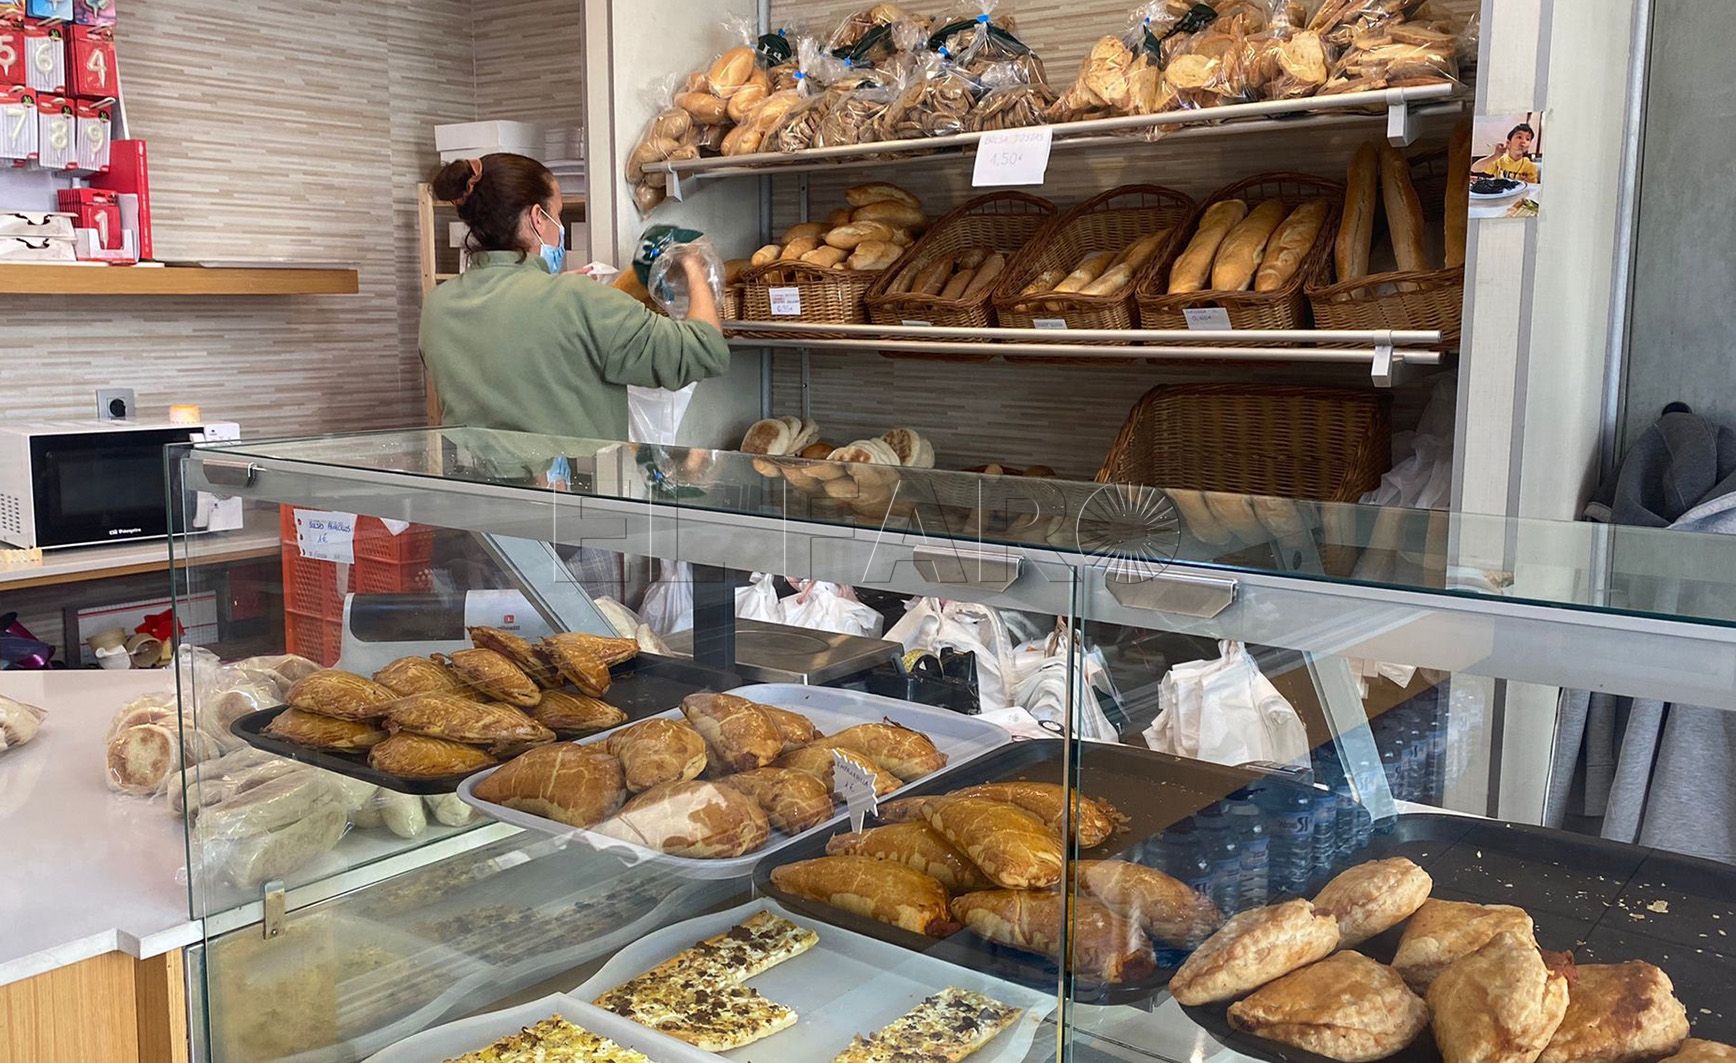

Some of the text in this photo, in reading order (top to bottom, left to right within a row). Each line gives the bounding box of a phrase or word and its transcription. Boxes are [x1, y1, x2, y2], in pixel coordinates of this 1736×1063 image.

[0, 35, 17, 66] 5
[35, 43, 54, 74] 6
[86, 49, 107, 84] 4
[6, 107, 27, 144] 7
[50, 119, 69, 150] 8
[86, 124, 104, 154] 9
[94, 210, 109, 246] 1
